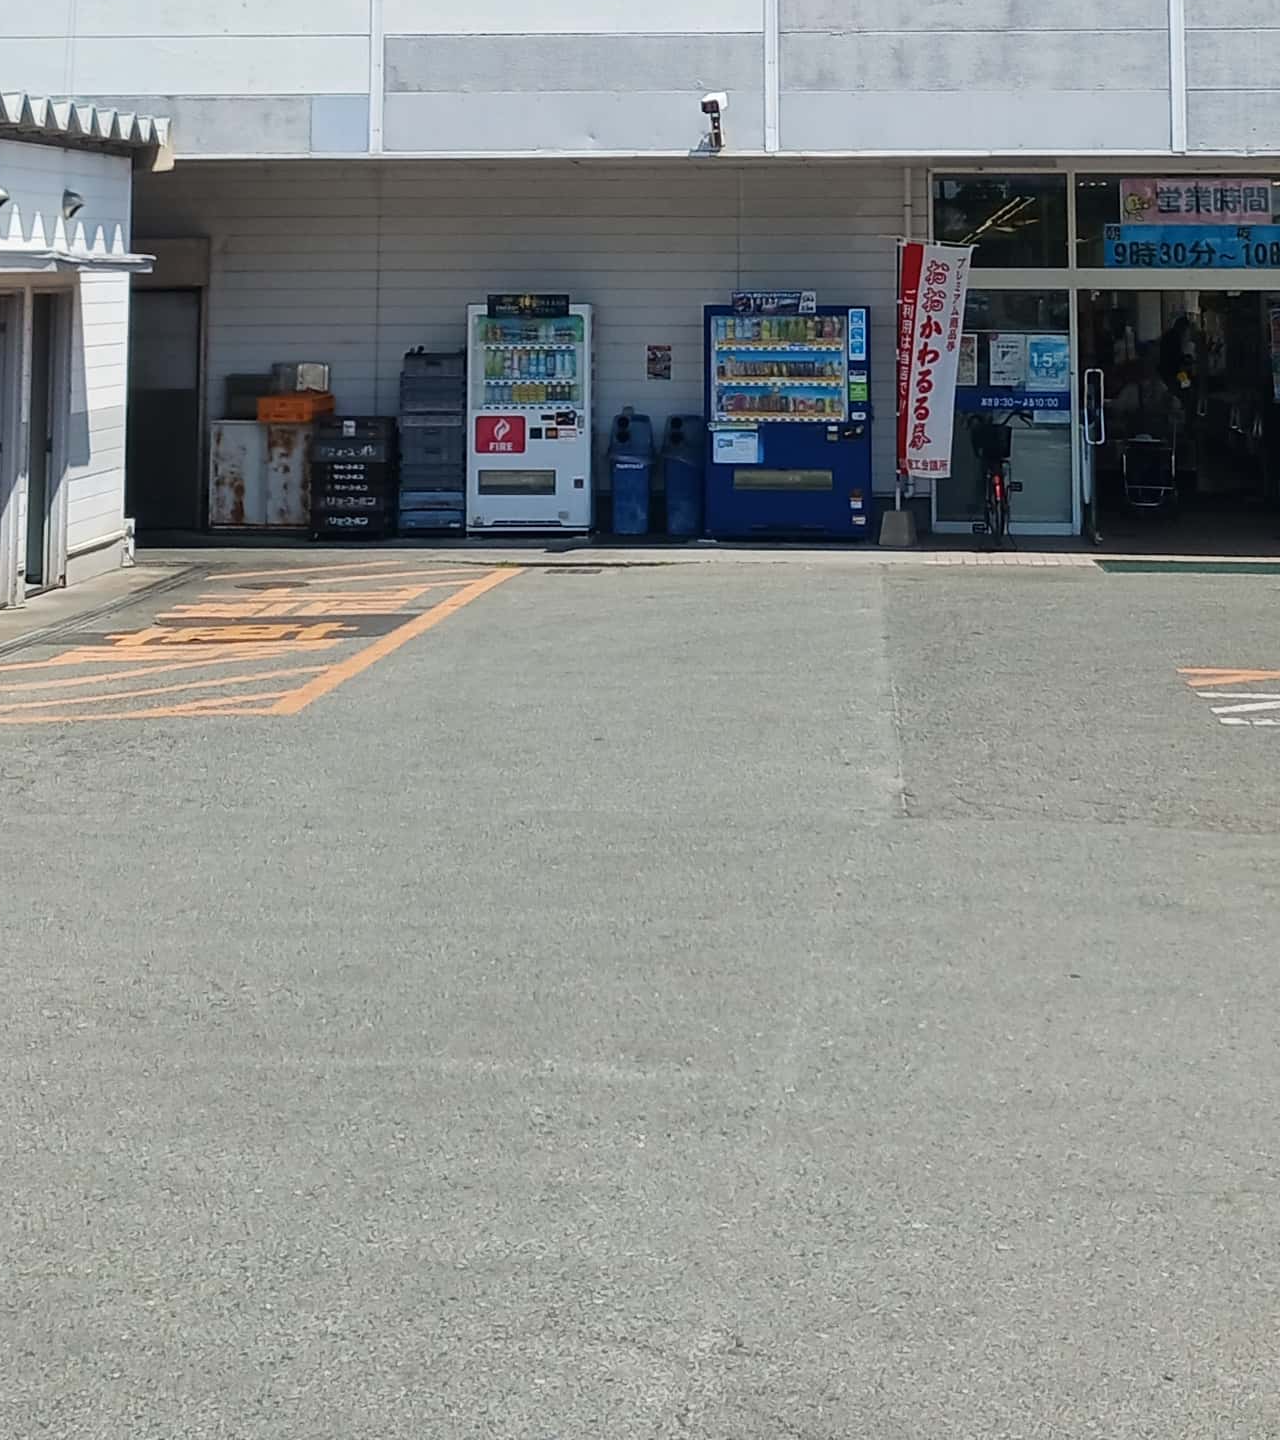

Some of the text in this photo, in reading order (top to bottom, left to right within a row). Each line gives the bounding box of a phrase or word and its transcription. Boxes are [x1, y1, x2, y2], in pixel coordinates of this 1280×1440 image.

[1158, 186, 1269, 213] 営業時間
[489, 442, 513, 452] FIRE
